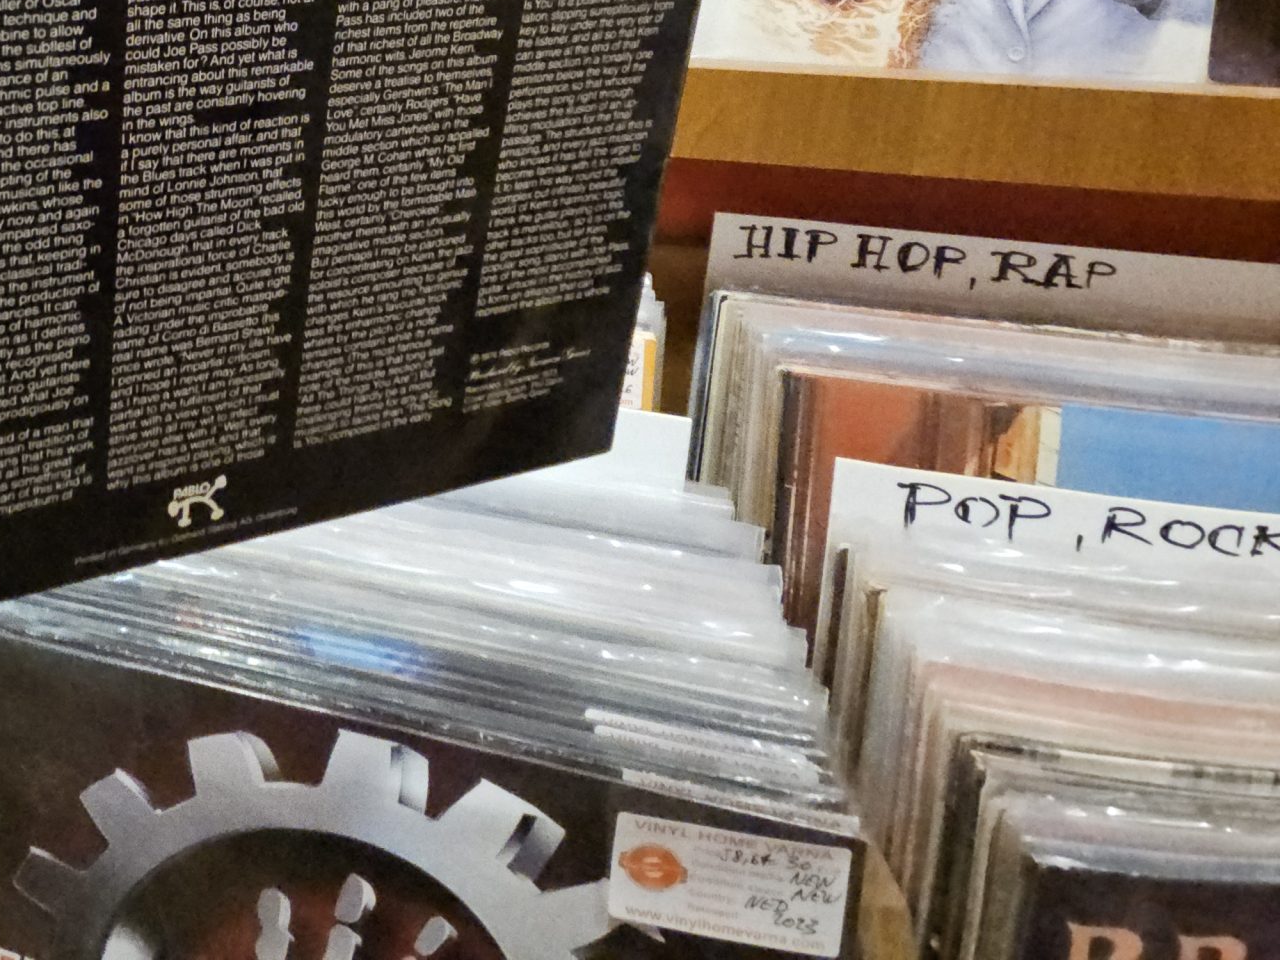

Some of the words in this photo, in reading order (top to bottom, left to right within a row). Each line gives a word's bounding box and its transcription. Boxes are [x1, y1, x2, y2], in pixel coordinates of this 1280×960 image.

[733, 224, 838, 261] HIP
[990, 250, 1117, 289] RAP
[173, 481, 211, 498] PABLO
[1101, 506, 1280, 557] ROCK
[634, 820, 688, 838] VINYL
[698, 831, 753, 850] HOME
[763, 842, 834, 860] VARNA
